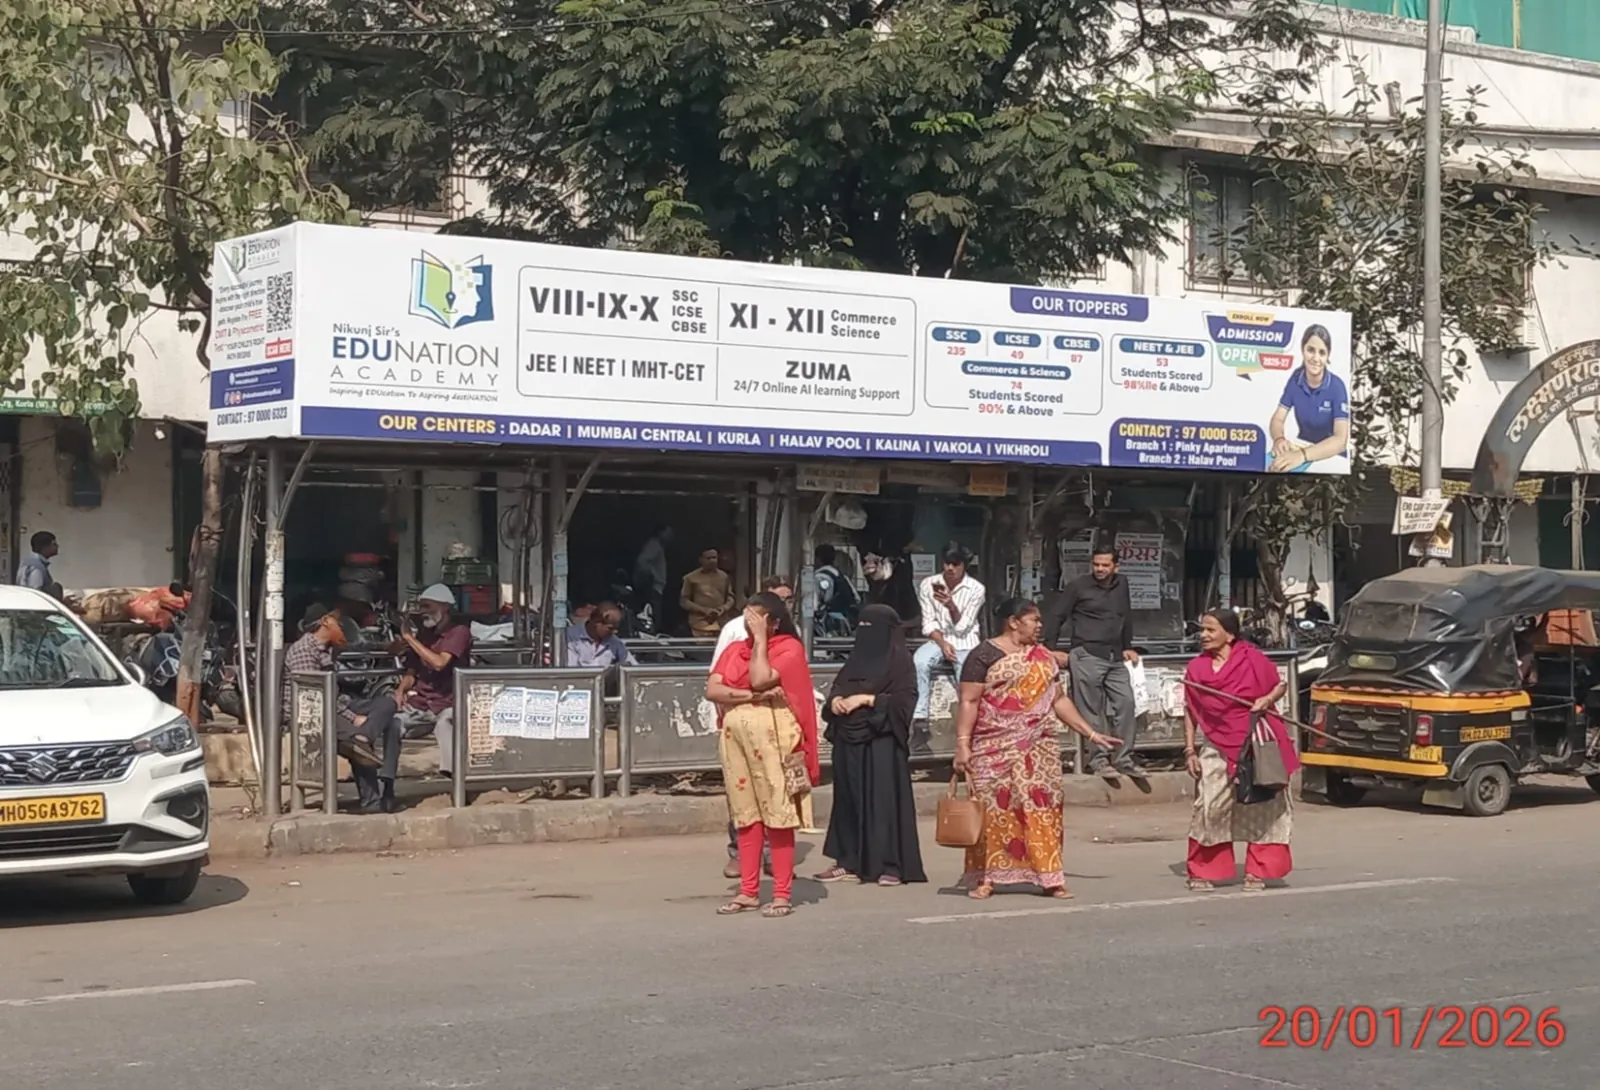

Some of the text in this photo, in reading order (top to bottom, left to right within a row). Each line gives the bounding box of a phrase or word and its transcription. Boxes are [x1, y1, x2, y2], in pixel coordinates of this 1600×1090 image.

[672, 290, 699, 302] SSC
[529, 285, 659, 323] VIII-IX-X
[672, 305, 703, 318] ICSE
[1032, 295, 1128, 317] OUR TOPPERS
[729, 302, 758, 330] XI
[786, 307, 824, 334] XII
[831, 310, 896, 326] Commerce
[332, 323, 400, 337] Nikunj Sir's
[671, 320, 707, 334] CBSE
[831, 325, 880, 340] Science
[945, 330, 968, 342] SSC
[1005, 334, 1031, 345] ICSE
[1218, 327, 1284, 343] ADMISSION
[947, 345, 966, 357] 235
[1063, 337, 1091, 350] CBSE
[1134, 341, 1162, 353] NEET
[1175, 344, 1195, 355] JEE
[332, 336, 499, 368] EDUNATION
[1010, 349, 1024, 360] 49
[1222, 348, 1257, 362] OPEN
[526, 354, 556, 373] JEE
[573, 356, 616, 376] NEET
[632, 360, 706, 382] MHT-CET
[967, 362, 1019, 377] Commerce
[1029, 366, 1066, 378] Science
[1156, 358, 1169, 368] 53
[330, 365, 498, 386] ACADEMY
[786, 361, 851, 382] ZUMA
[1121, 367, 1203, 381] Students Scored
[329, 387, 363, 398] Inspiring
[734, 380, 760, 392] 24/7
[762, 381, 798, 394] Online
[814, 384, 857, 400] learning
[859, 386, 900, 401] Support
[1010, 381, 1023, 390] 74
[1169, 383, 1200, 393] Above
[969, 388, 1063, 404] Students Scored
[979, 403, 1054, 416] 90% & Above
[217, 412, 243, 426] CONTACT
[248, 411, 255, 423] 97
[379, 415, 418, 431] OUR
[423, 416, 496, 434] CENTERS
[509, 422, 562, 438] DADAR
[578, 425, 636, 441] MUMBAI
[641, 428, 702, 444] CENTRAL
[718, 433, 761, 446] KURLA
[780, 435, 823, 449] HALAV
[826, 436, 863, 450] POOL
[875, 438, 921, 453] KALINA
[933, 440, 982, 456] VAKOLA
[995, 442, 1049, 458] VIKHROLI
[1119, 423, 1172, 438] CONTACT
[1182, 426, 1197, 439] 97
[1200, 427, 1227, 440] 0000
[1230, 429, 1257, 442] 6323
[1126, 439, 1156, 451] Branch
[1175, 440, 1200, 454] Pinky
[1202, 443, 1250, 456] Apartment
[1139, 452, 1171, 465] Branch
[1215, 456, 1237, 468] Pool
